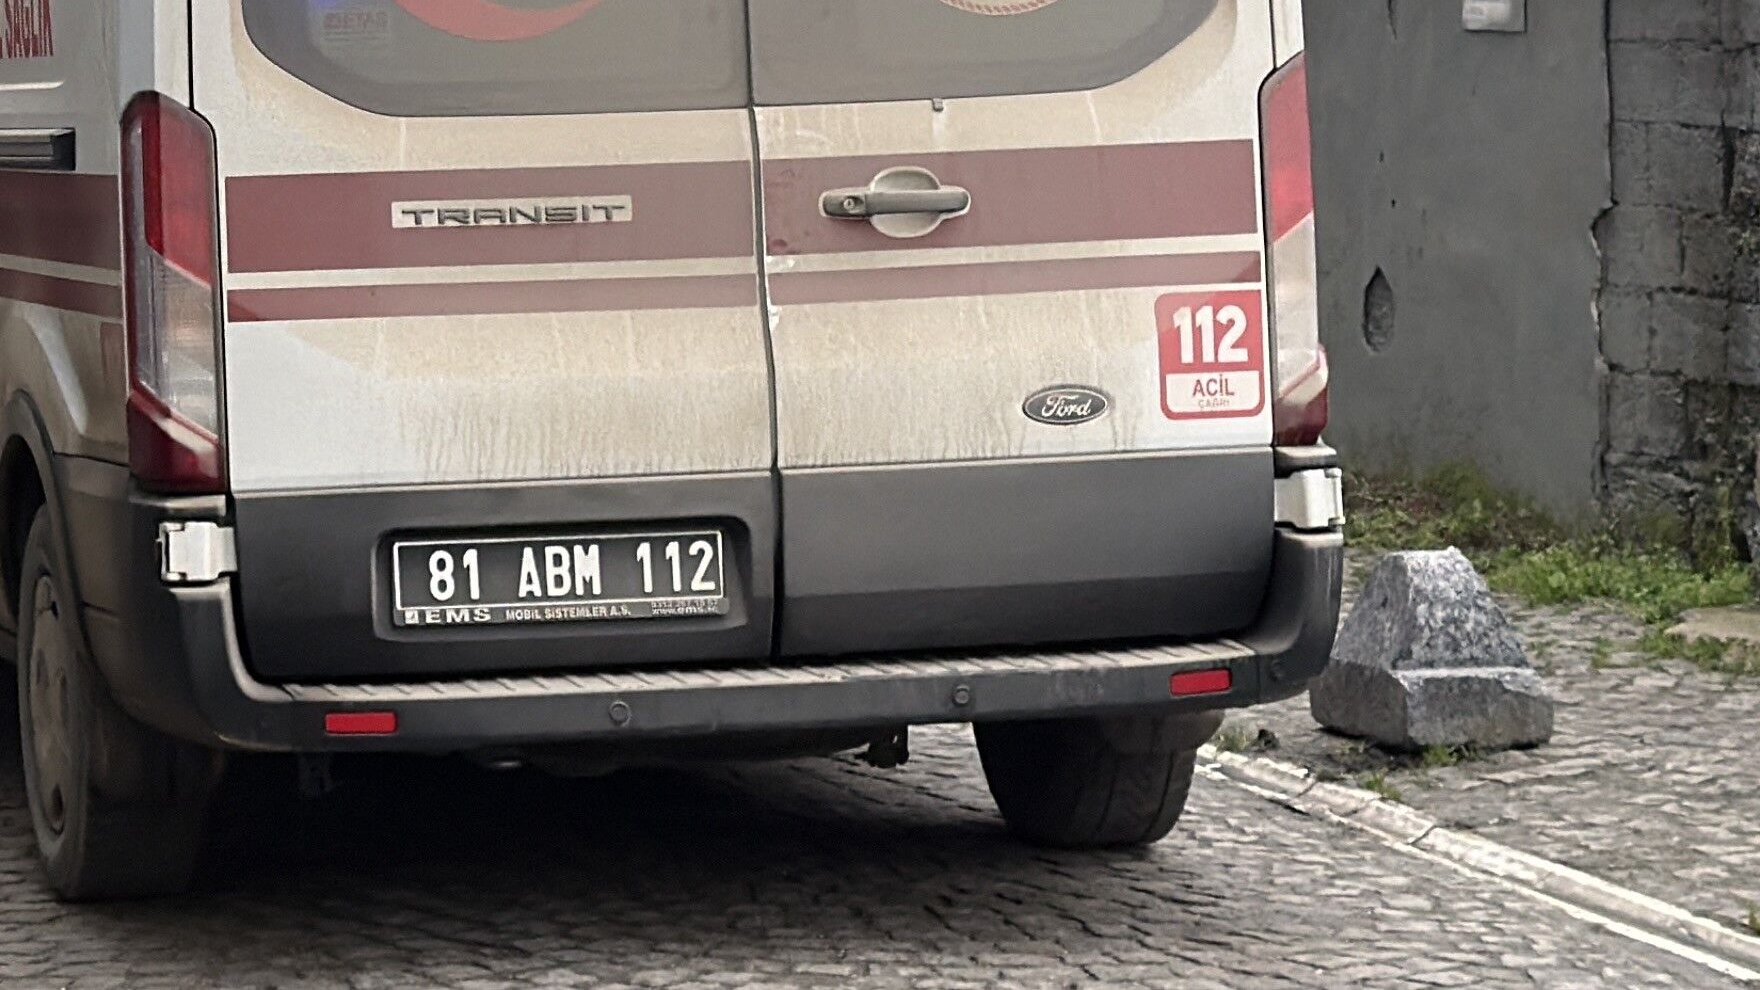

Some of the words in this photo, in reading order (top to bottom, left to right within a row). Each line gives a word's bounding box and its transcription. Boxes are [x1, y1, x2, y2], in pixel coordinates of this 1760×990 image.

[402, 204, 626, 226] TRANSIT
[1173, 305, 1249, 364] 112
[1192, 373, 1235, 397] ACİL
[1041, 394, 1092, 418] Ford
[429, 550, 480, 601] 81
[518, 544, 601, 598] ABM
[637, 540, 716, 594] 112
[425, 609, 491, 624] EMS
